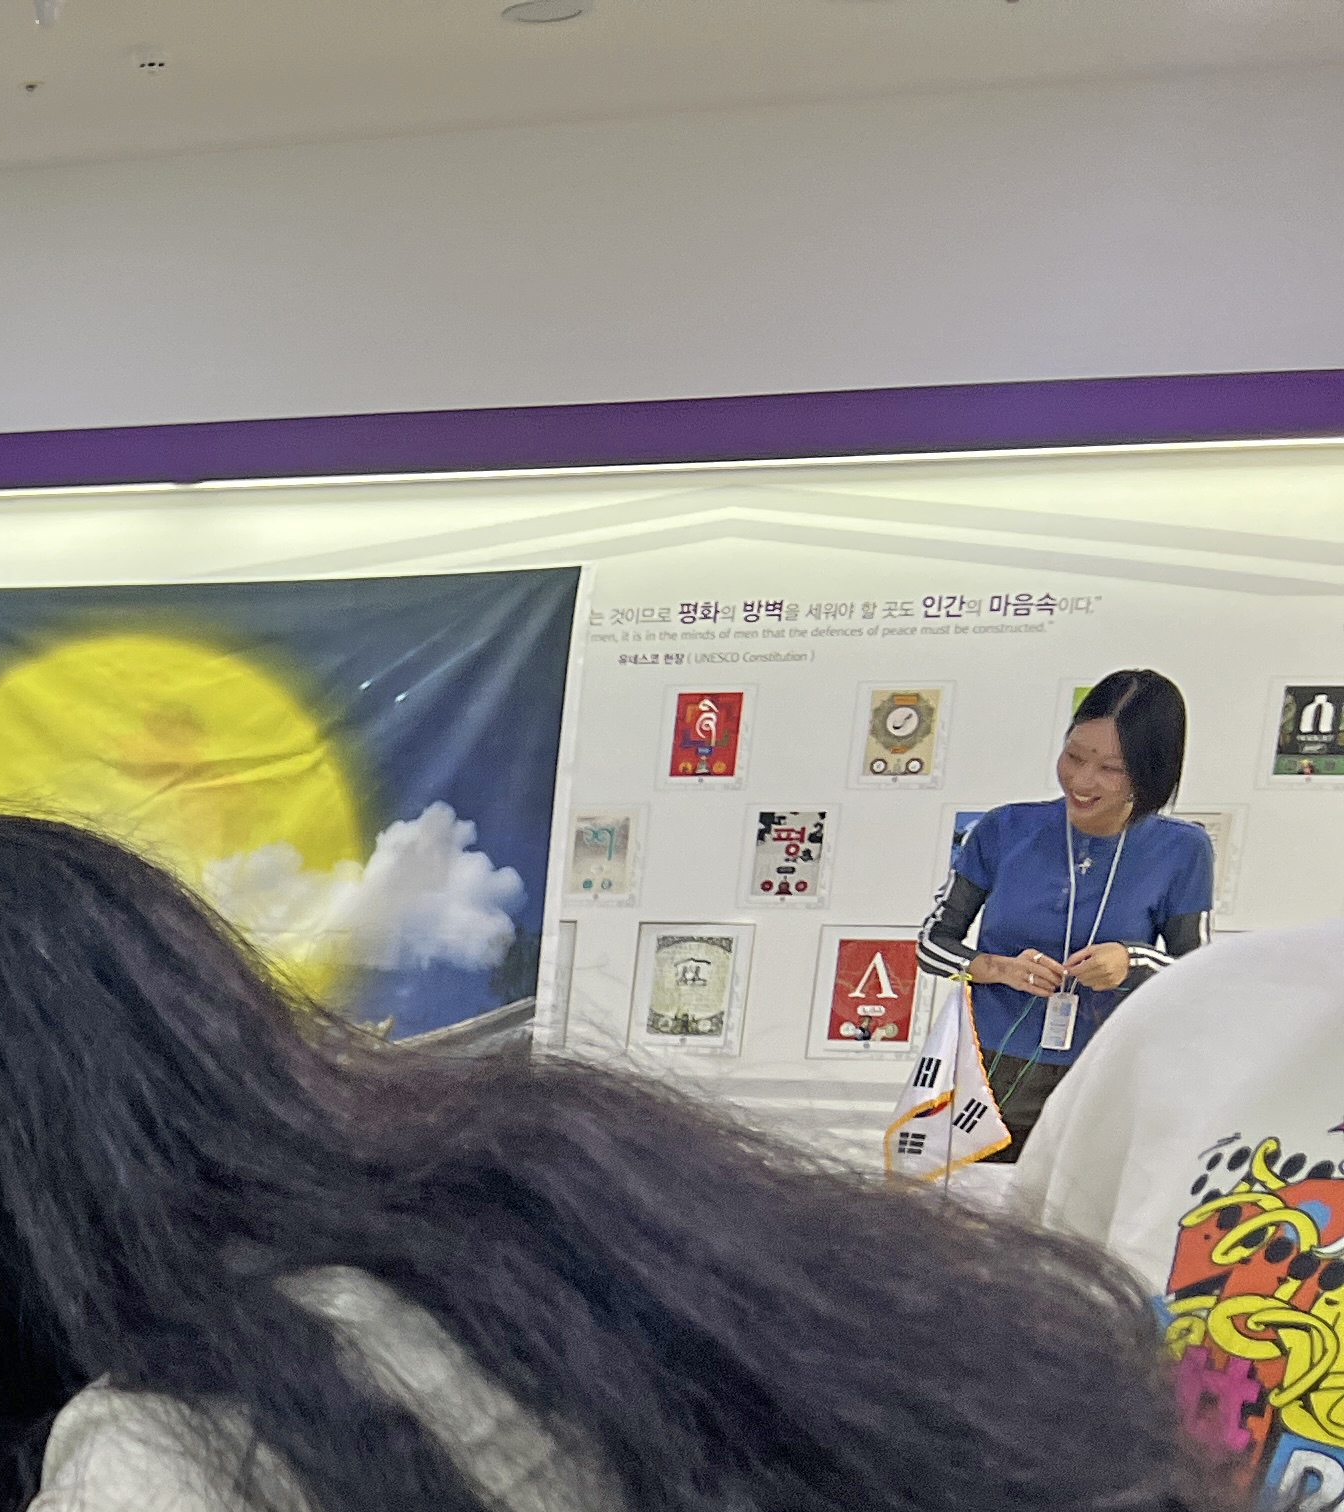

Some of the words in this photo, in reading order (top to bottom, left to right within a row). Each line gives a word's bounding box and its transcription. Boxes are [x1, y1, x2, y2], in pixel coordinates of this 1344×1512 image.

[611, 607, 672, 625] 것이므로
[678, 600, 736, 624] 평화의
[742, 599, 800, 623] 방벽을
[805, 601, 855, 621] 세워야
[862, 601, 877, 620] 할
[882, 601, 914, 619] 곳도
[922, 595, 982, 619] 인간의
[621, 630, 630, 642] it
[633, 630, 642, 642] is
[645, 630, 656, 641] in
[659, 629, 678, 641] the
[681, 628, 715, 641] minds
[719, 628, 731, 640] of
[734, 629, 759, 639] men
[763, 627, 786, 639] that
[789, 627, 808, 639] the
[811, 624, 863, 638] defences
[867, 623, 879, 636] of
[882, 625, 917, 638] peace
[920, 624, 950, 635] must
[954, 623, 969, 634] be
[618, 653, 659, 665] 유네스코
